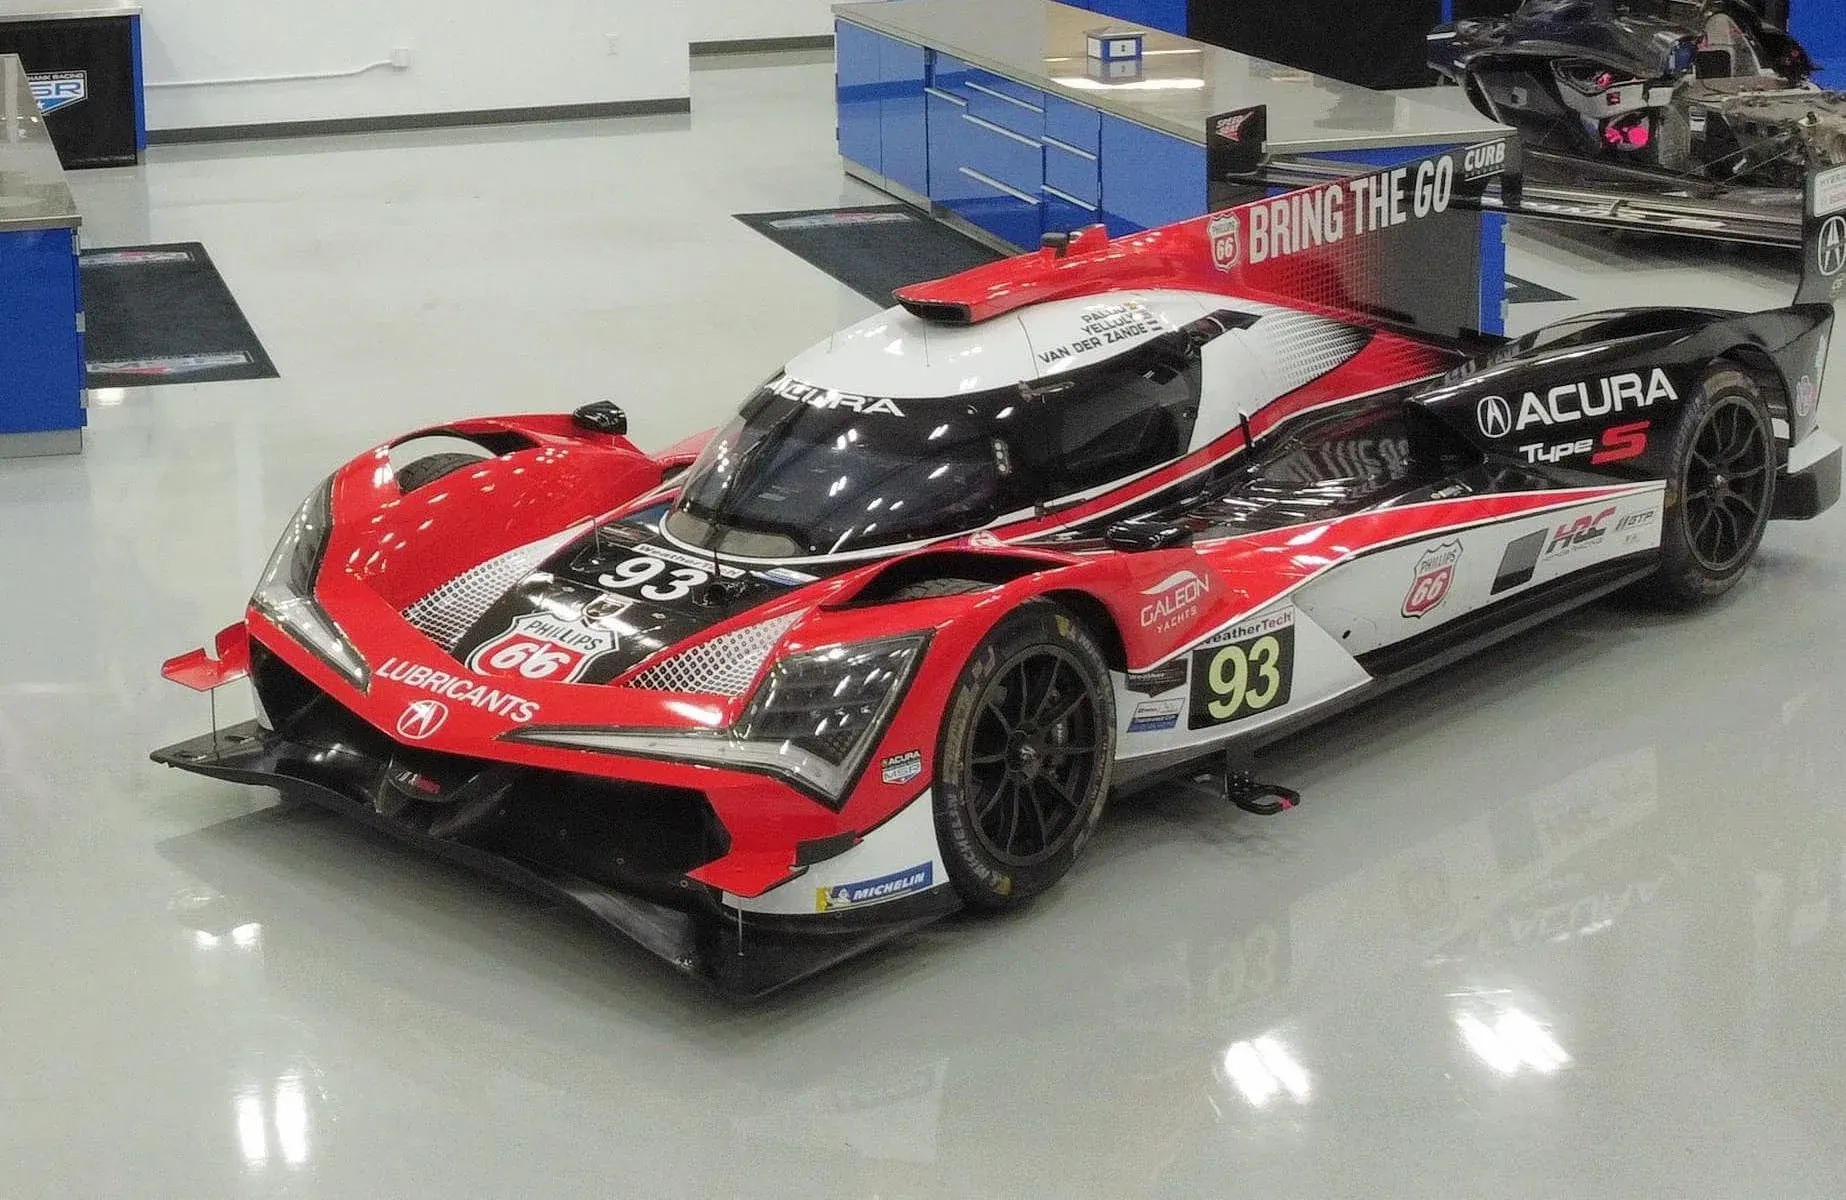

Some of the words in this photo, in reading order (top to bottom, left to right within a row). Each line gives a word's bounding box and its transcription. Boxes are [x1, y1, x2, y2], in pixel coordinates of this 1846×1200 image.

[30, 81, 81, 96] SR
[1464, 142, 1506, 172] CURB
[1250, 184, 1344, 264] BRING
[1350, 167, 1408, 235] THE
[1413, 155, 1454, 219] GO
[1216, 237, 1233, 261] 66
[1038, 346, 1071, 363] VAN
[1072, 337, 1102, 353] DER
[1103, 323, 1148, 343] ZANDE
[1515, 367, 1679, 431] ACURA
[1519, 438, 1594, 464] Type
[1590, 420, 1650, 465] S
[1546, 506, 1617, 554] HRC
[598, 556, 708, 601] 93
[1420, 549, 1458, 576] PHILLIPS
[1140, 573, 1210, 628] GALEON
[1411, 572, 1448, 607] 66
[522, 619, 603, 651] PHILLIPS
[1156, 608, 1198, 634] YACHTS
[490, 643, 571, 680] 66
[1207, 635, 1281, 719] 93
[375, 657, 541, 723] LUBRICANTS
[889, 751, 920, 766] ACURA
[853, 872, 925, 901] MICHELIN
